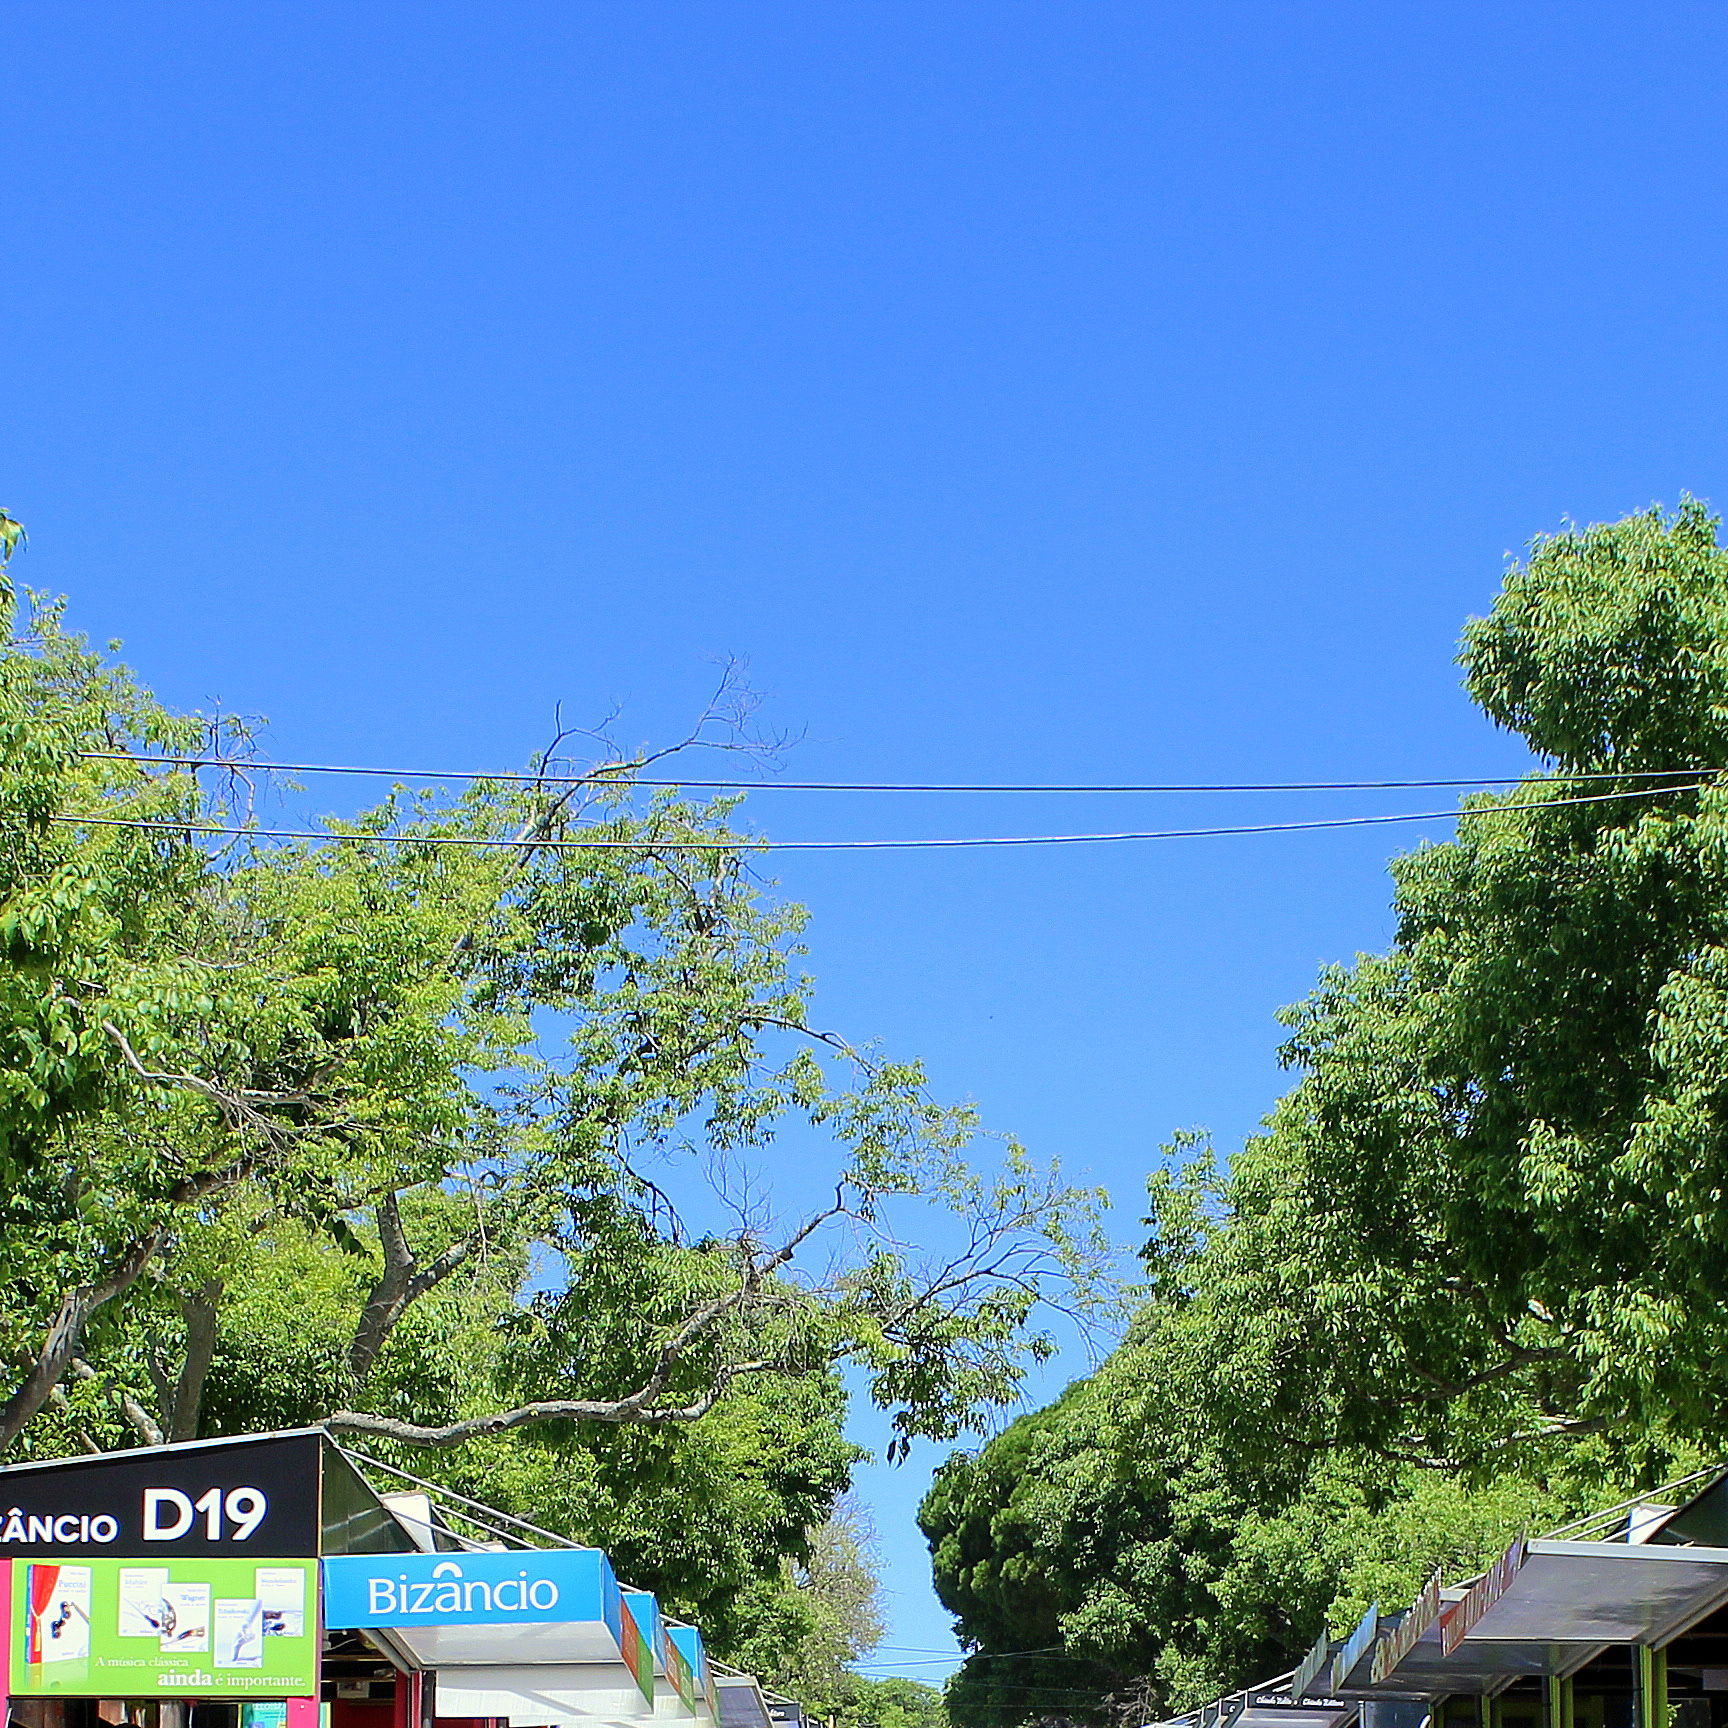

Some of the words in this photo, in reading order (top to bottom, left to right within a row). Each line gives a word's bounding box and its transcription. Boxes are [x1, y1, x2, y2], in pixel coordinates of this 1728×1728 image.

[143, 1487, 268, 1542] D19
[368, 1562, 559, 1615] Bizâncio
[95, 1656, 106, 1667] A
[108, 1656, 146, 1667] música
[148, 1656, 189, 1667] clássica
[158, 1669, 212, 1686] ainda
[227, 1673, 305, 1691] importante.
